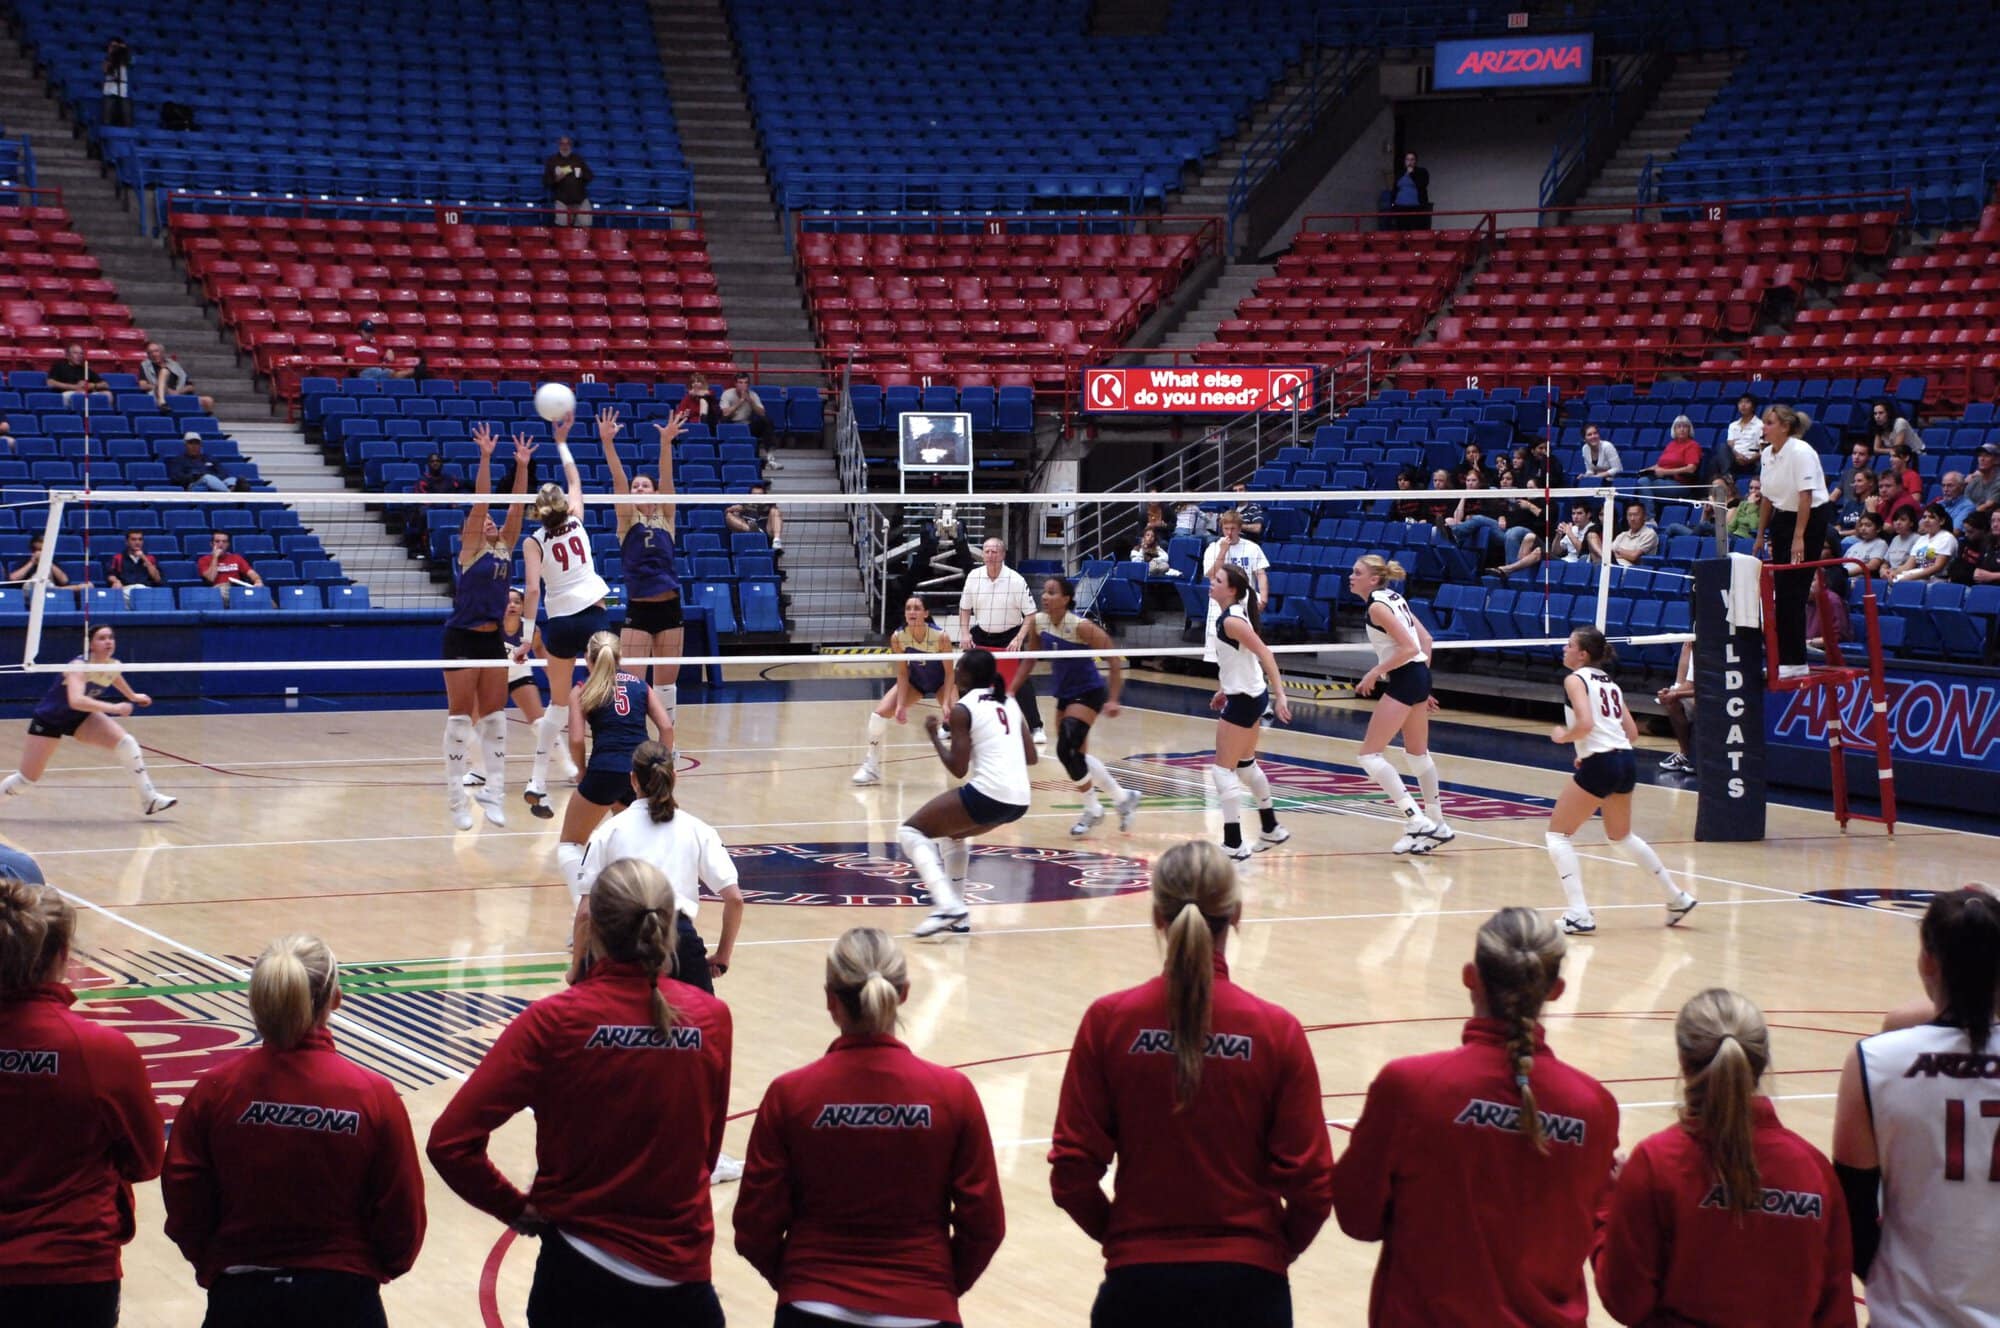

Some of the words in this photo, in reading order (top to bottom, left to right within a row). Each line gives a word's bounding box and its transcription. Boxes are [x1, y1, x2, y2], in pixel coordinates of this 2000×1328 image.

[1456, 46, 1583, 75] ARIZONA
[445, 212, 458, 224] 10
[1708, 207, 1721, 221] 12
[990, 222, 1000, 234] 11
[581, 372, 596, 385] 10
[921, 375, 932, 388] 11
[1151, 371, 1199, 388] What
[1203, 371, 1243, 388] else
[1466, 375, 1479, 390] 12
[1134, 388, 1159, 405] do
[1162, 390, 1197, 409] you
[1200, 388, 1259, 405] need?
[644, 529, 656, 548] 2
[552, 535, 588, 572] 99
[613, 685, 631, 716] 5
[1599, 686, 1623, 719] 33
[996, 707, 1010, 735] 9
[584, 1024, 702, 1051] ARIZONA
[0, 1049, 59, 1076] ONA
[238, 1100, 360, 1136] ARIZONA
[812, 1103, 932, 1129] ARIZONA
